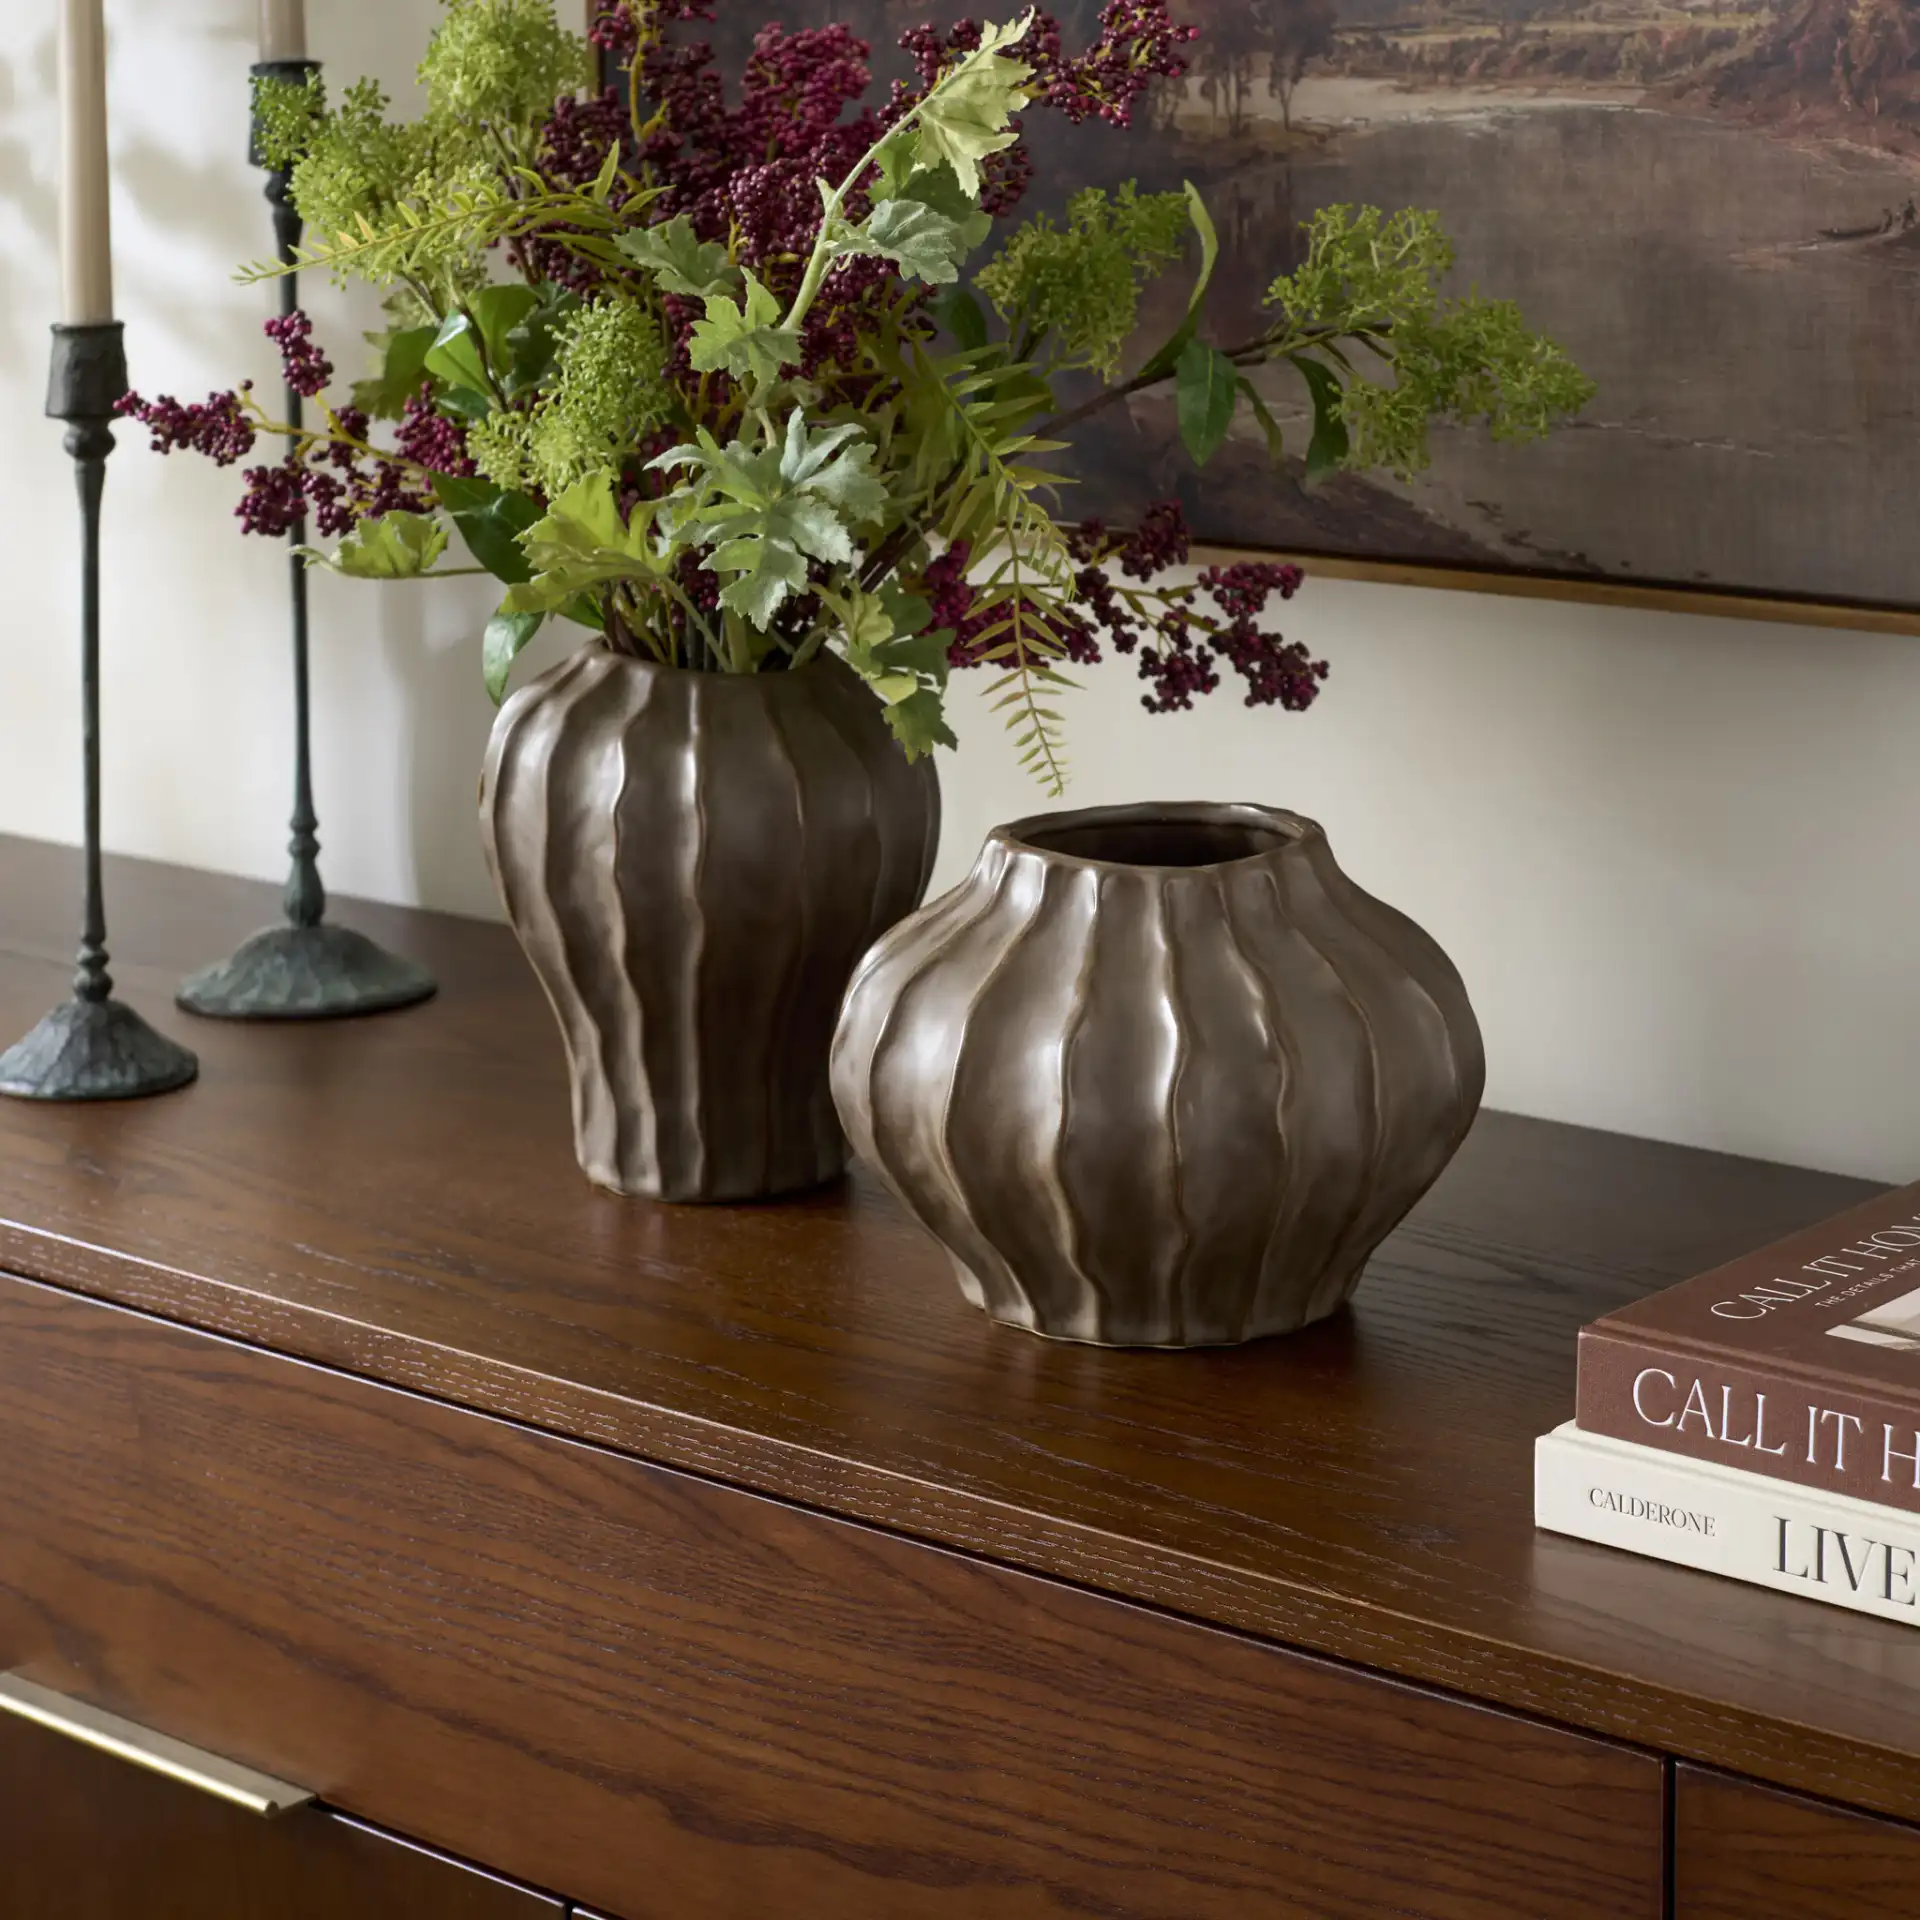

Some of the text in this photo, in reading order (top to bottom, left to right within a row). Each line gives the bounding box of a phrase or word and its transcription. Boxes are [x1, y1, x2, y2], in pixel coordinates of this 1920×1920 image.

[1711, 1278, 1831, 1320] CALL
[1802, 1255, 1864, 1278] IT
[1814, 1295, 1846, 1308] THE
[1840, 1272, 1894, 1297] DETAILS
[1632, 1367, 1788, 1456] CALL
[1806, 1405, 1864, 1472] IT
[1588, 1487, 1916, 1606] CALDERONE LIVE
